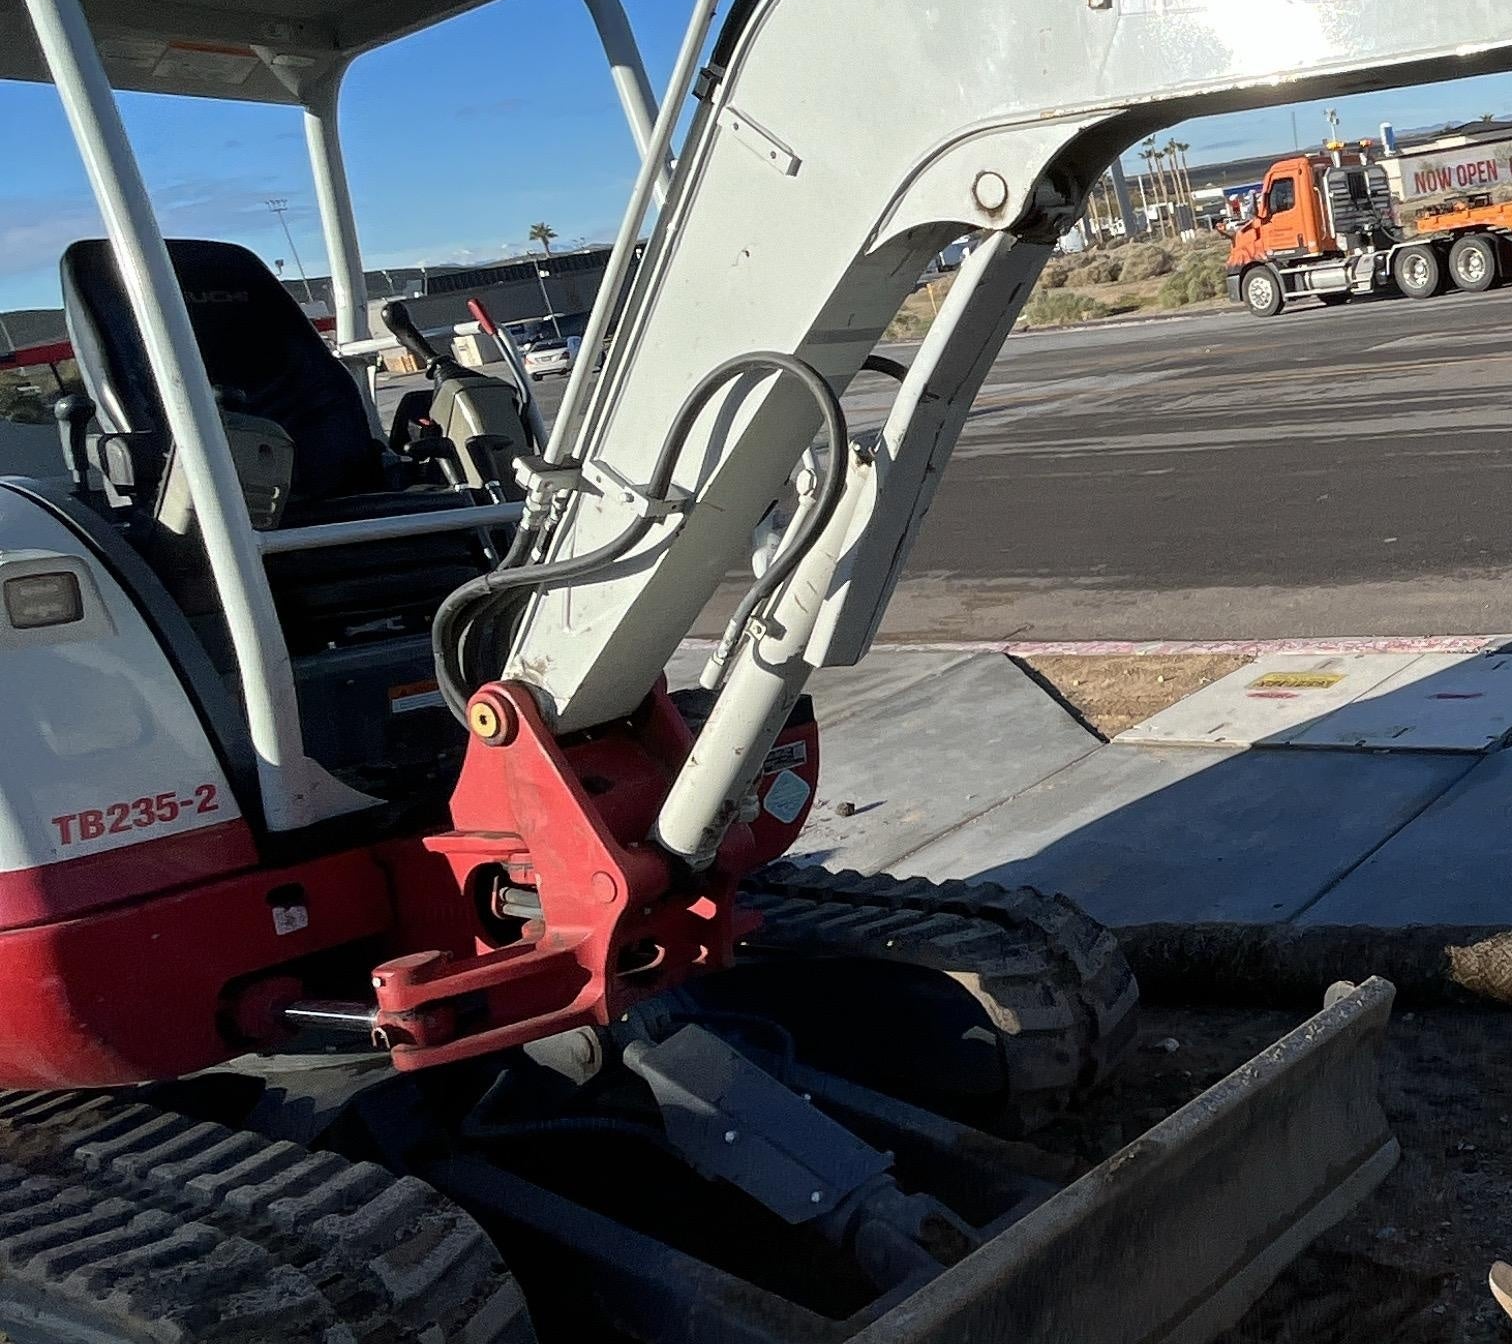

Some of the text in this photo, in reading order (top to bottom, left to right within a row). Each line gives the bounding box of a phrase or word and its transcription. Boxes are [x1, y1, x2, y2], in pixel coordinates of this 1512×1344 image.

[1413, 169, 1452, 194] NOW
[1456, 159, 1498, 187] OPEN
[51, 783, 219, 846] TB235-2
